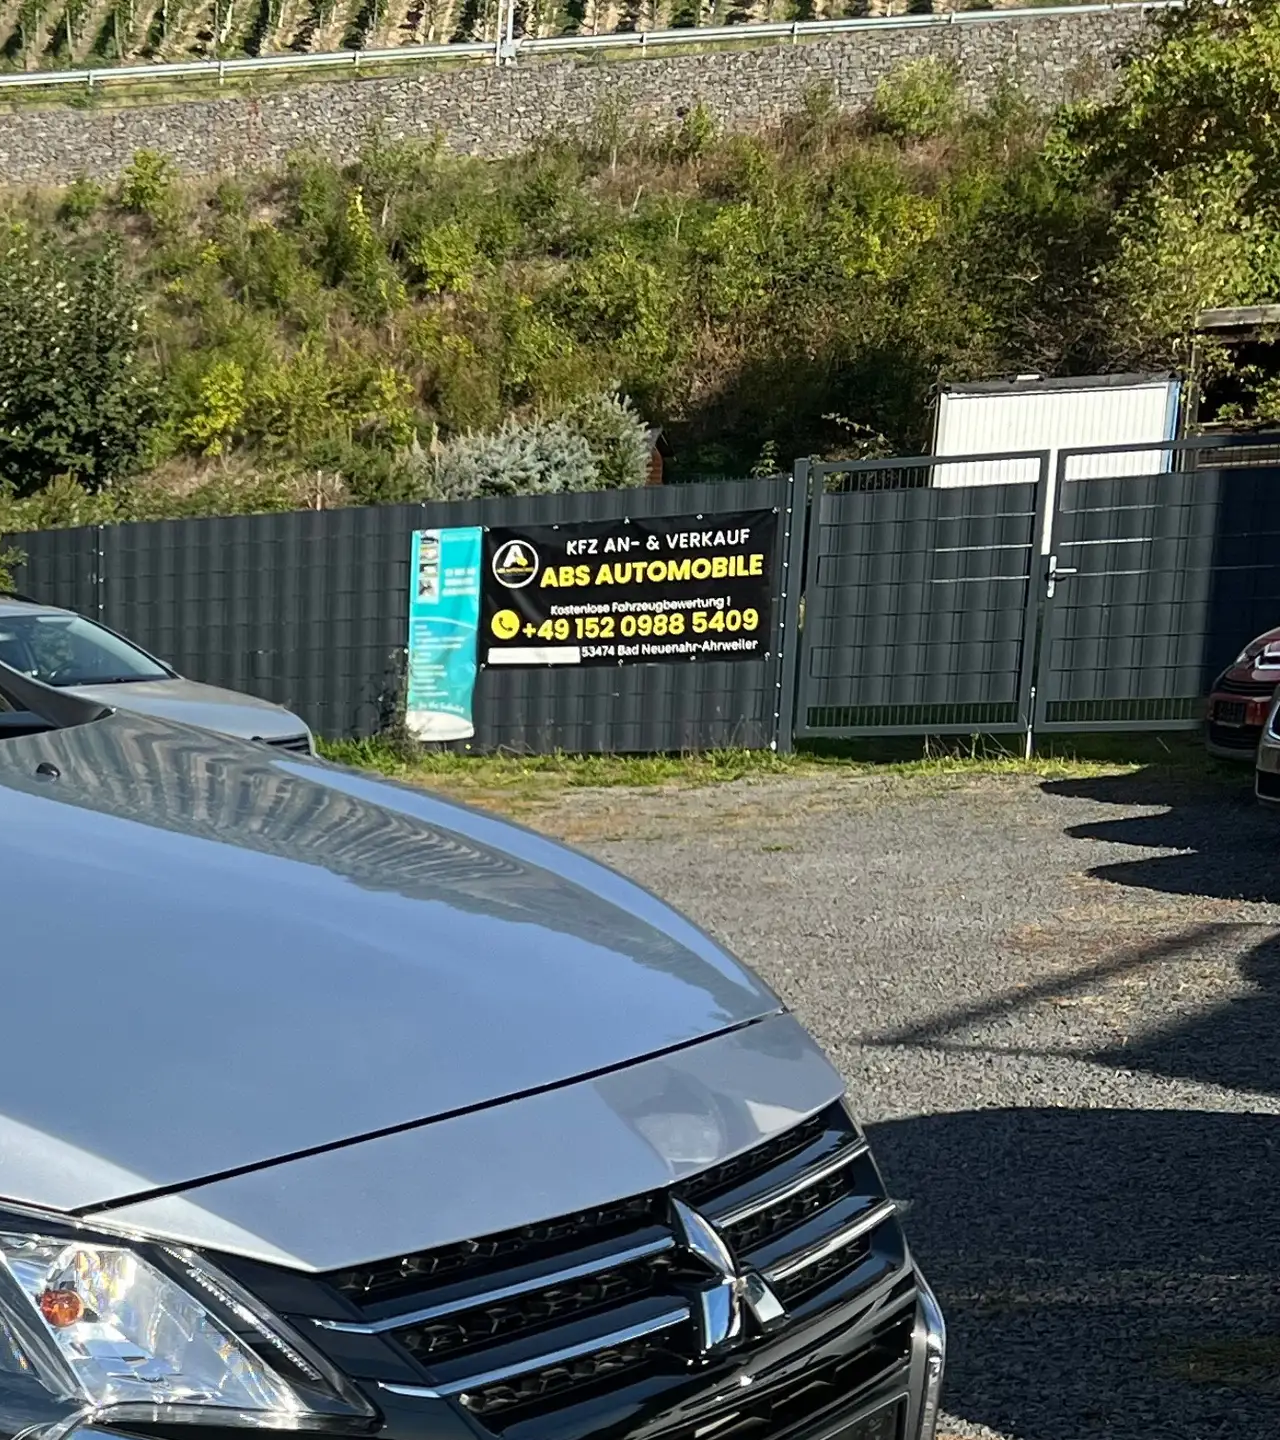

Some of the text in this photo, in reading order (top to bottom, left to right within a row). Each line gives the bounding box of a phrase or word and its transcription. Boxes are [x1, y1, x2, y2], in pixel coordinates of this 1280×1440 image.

[566, 528, 751, 556] KFZ AN- & VERKAUF
[540, 553, 764, 588] ABS AUTOMOBILE
[550, 603, 611, 616] Kostenlose
[611, 597, 725, 614] Fahrzeugbewertung
[522, 608, 759, 640] +49 152 0988 5409
[581, 638, 759, 658] 53474 Bad Neuenahr-Ahrweiler
